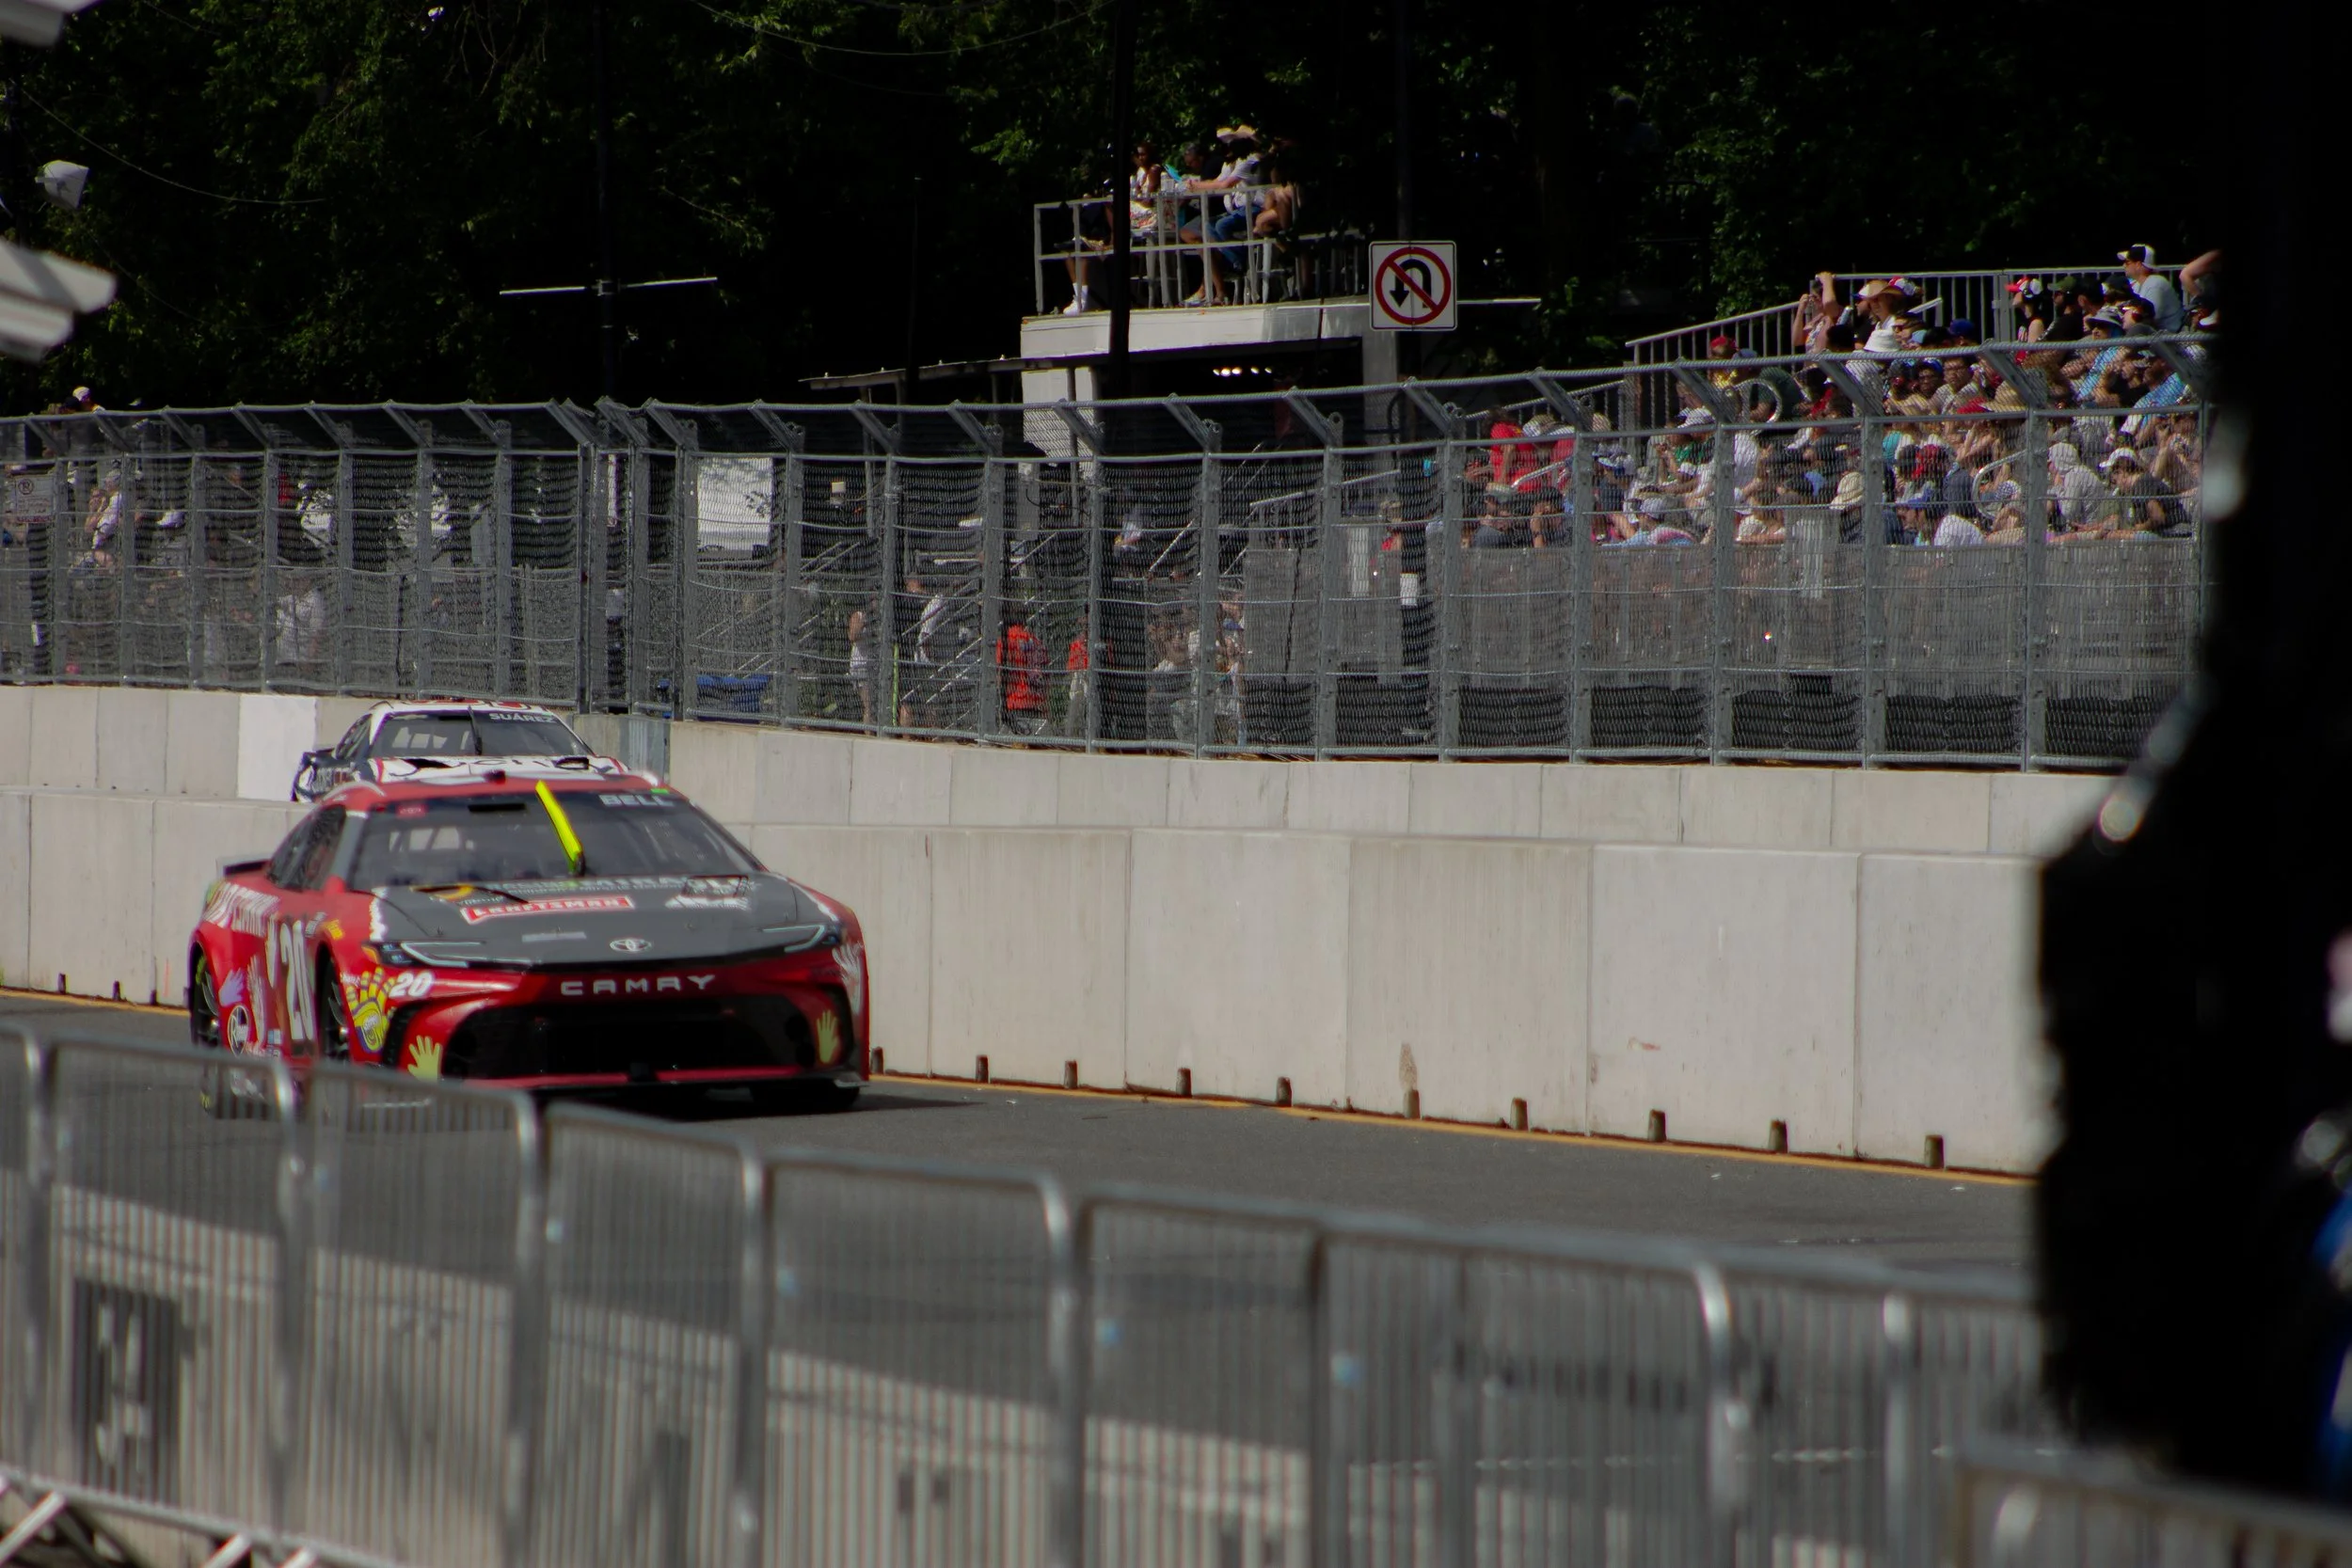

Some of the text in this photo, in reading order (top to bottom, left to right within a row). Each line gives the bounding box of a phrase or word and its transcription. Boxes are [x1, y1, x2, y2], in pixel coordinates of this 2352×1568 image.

[598, 794, 674, 807] BELL
[280, 920, 314, 1041] 20
[389, 971, 434, 997] 20
[561, 975, 716, 996] CAMRY
